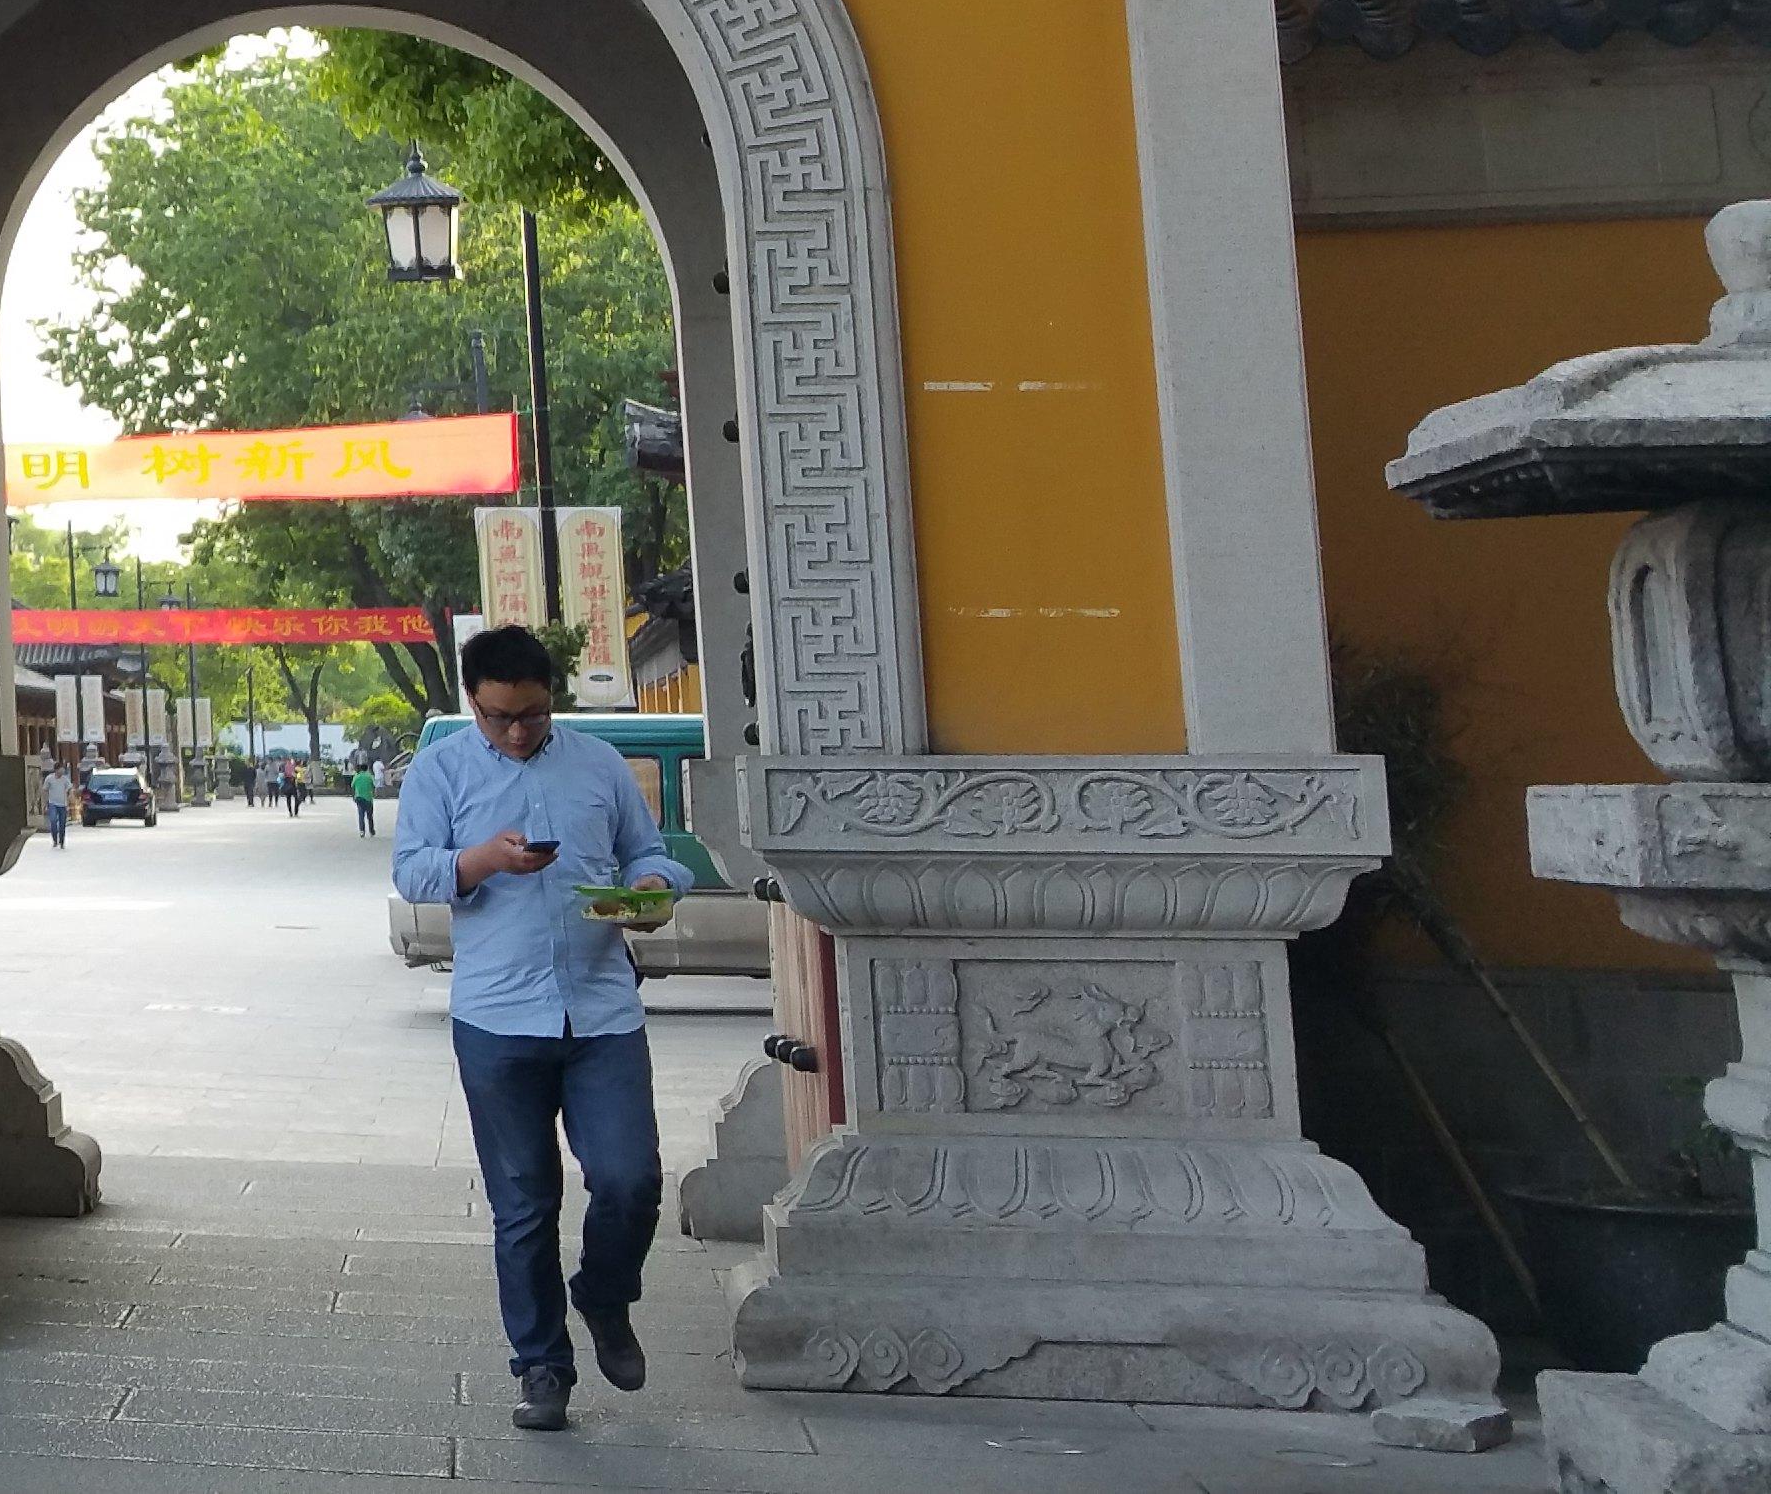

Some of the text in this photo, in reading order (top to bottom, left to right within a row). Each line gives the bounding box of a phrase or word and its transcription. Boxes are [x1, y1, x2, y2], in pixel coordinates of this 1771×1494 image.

[21, 440, 412, 490] 明 树新风
